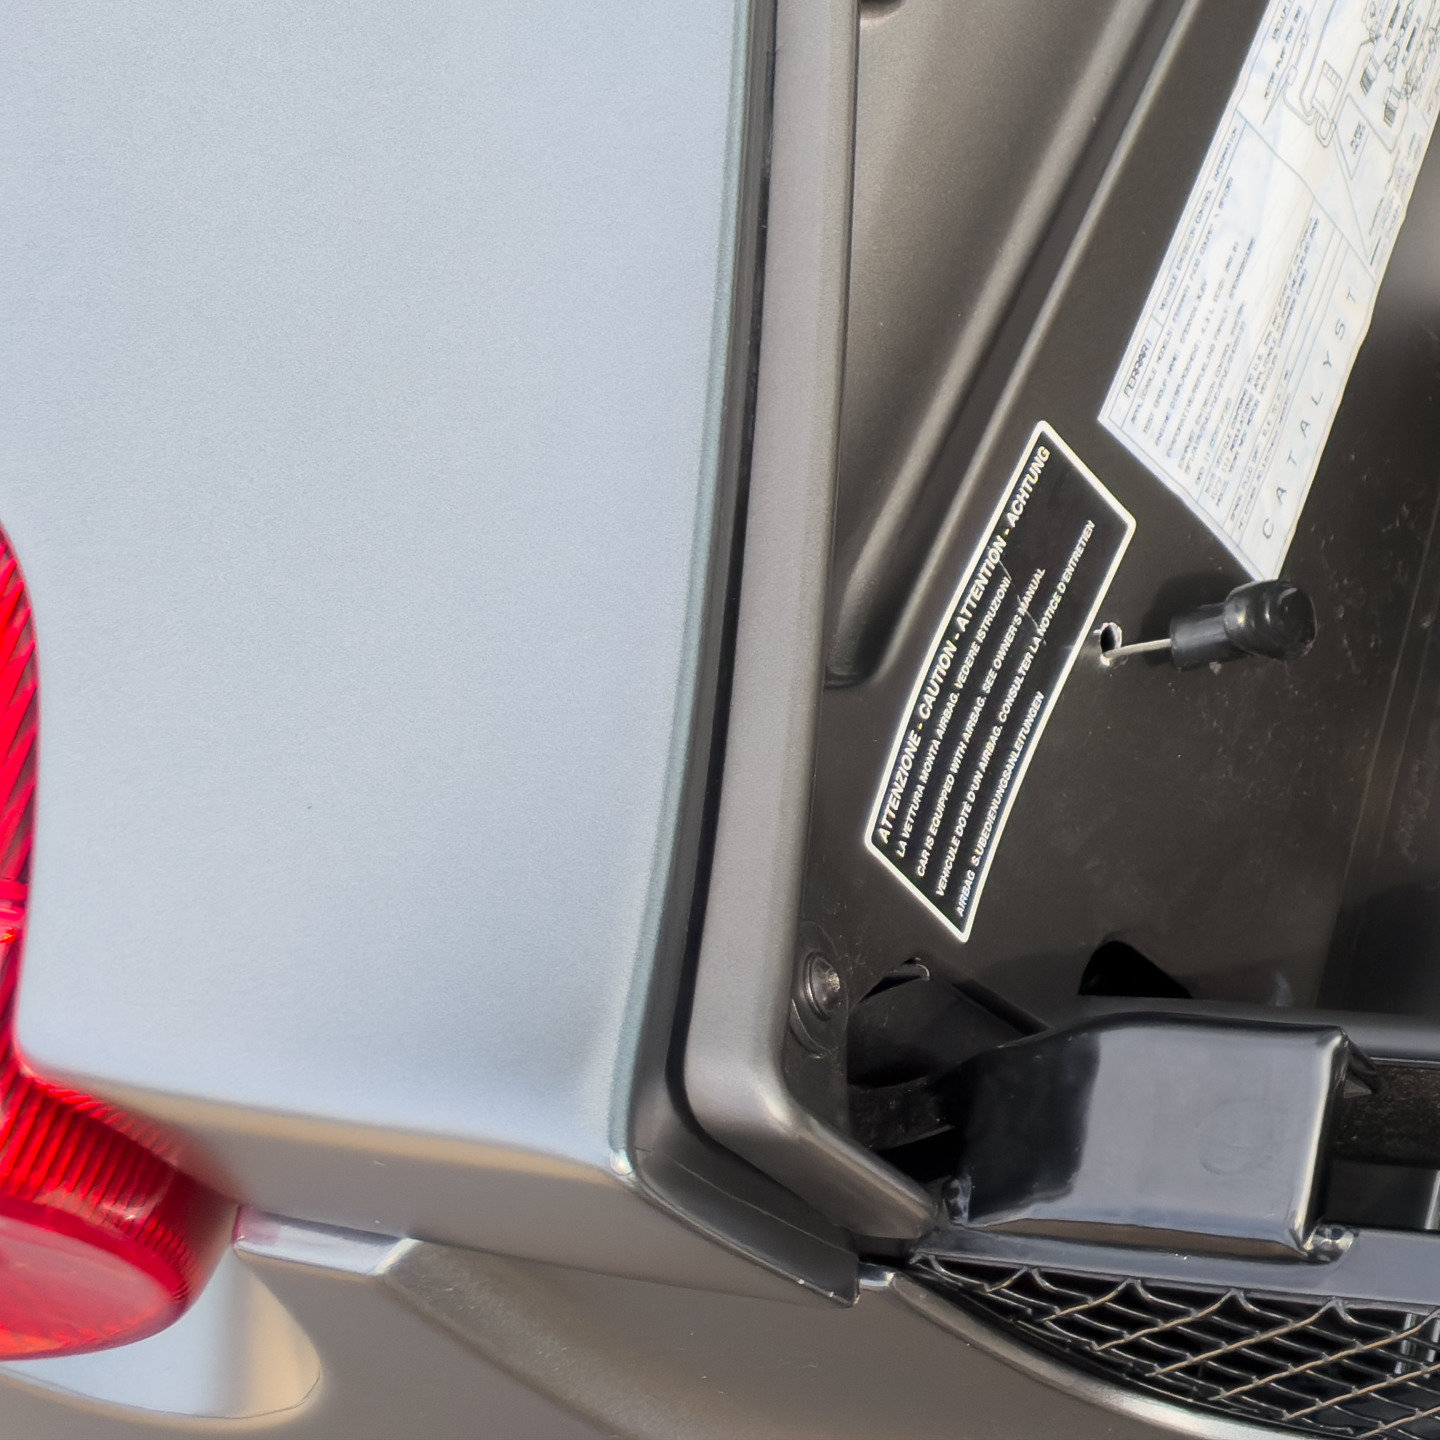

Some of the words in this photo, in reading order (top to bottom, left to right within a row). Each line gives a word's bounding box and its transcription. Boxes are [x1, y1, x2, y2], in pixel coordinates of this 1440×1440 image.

[1122, 336, 1152, 399] FERRARI
[1260, 286, 1358, 542] CATALYST
[975, 574, 1011, 644] ISTRUZIONI
[1017, 562, 1046, 616] MANUAL
[876, 727, 922, 845] ATTENZIONE
[917, 637, 957, 722] CAUTION
[954, 533, 1007, 634] ATTENTION
[1005, 442, 1050, 528] ACHTUNG
[954, 639, 981, 691] VEDERE
[992, 612, 1023, 672] OWNER'S
[934, 834, 961, 899] VEHICULE
[966, 768, 983, 803] D'UN
[978, 720, 1003, 773] AIRBAG.
[997, 650, 1034, 724] CONSULTER
[1028, 633, 1042, 654] LA
[1036, 589, 1062, 638] NOTICE
[1056, 517, 1095, 594] D'ENTRETIEN
[981, 667, 998, 696] SEE
[935, 686, 960, 739] AIRBAG.
[962, 691, 986, 743] AIRBAG.
[919, 735, 941, 785] MONTA
[949, 739, 967, 775] WITH
[901, 781, 925, 841] VETTURA
[928, 771, 955, 837] EQUIPPED
[896, 837, 907, 858] LA
[916, 846, 930, 878] CAR
[924, 833, 935, 851] IS
[955, 867, 975, 918] AIRBAG
